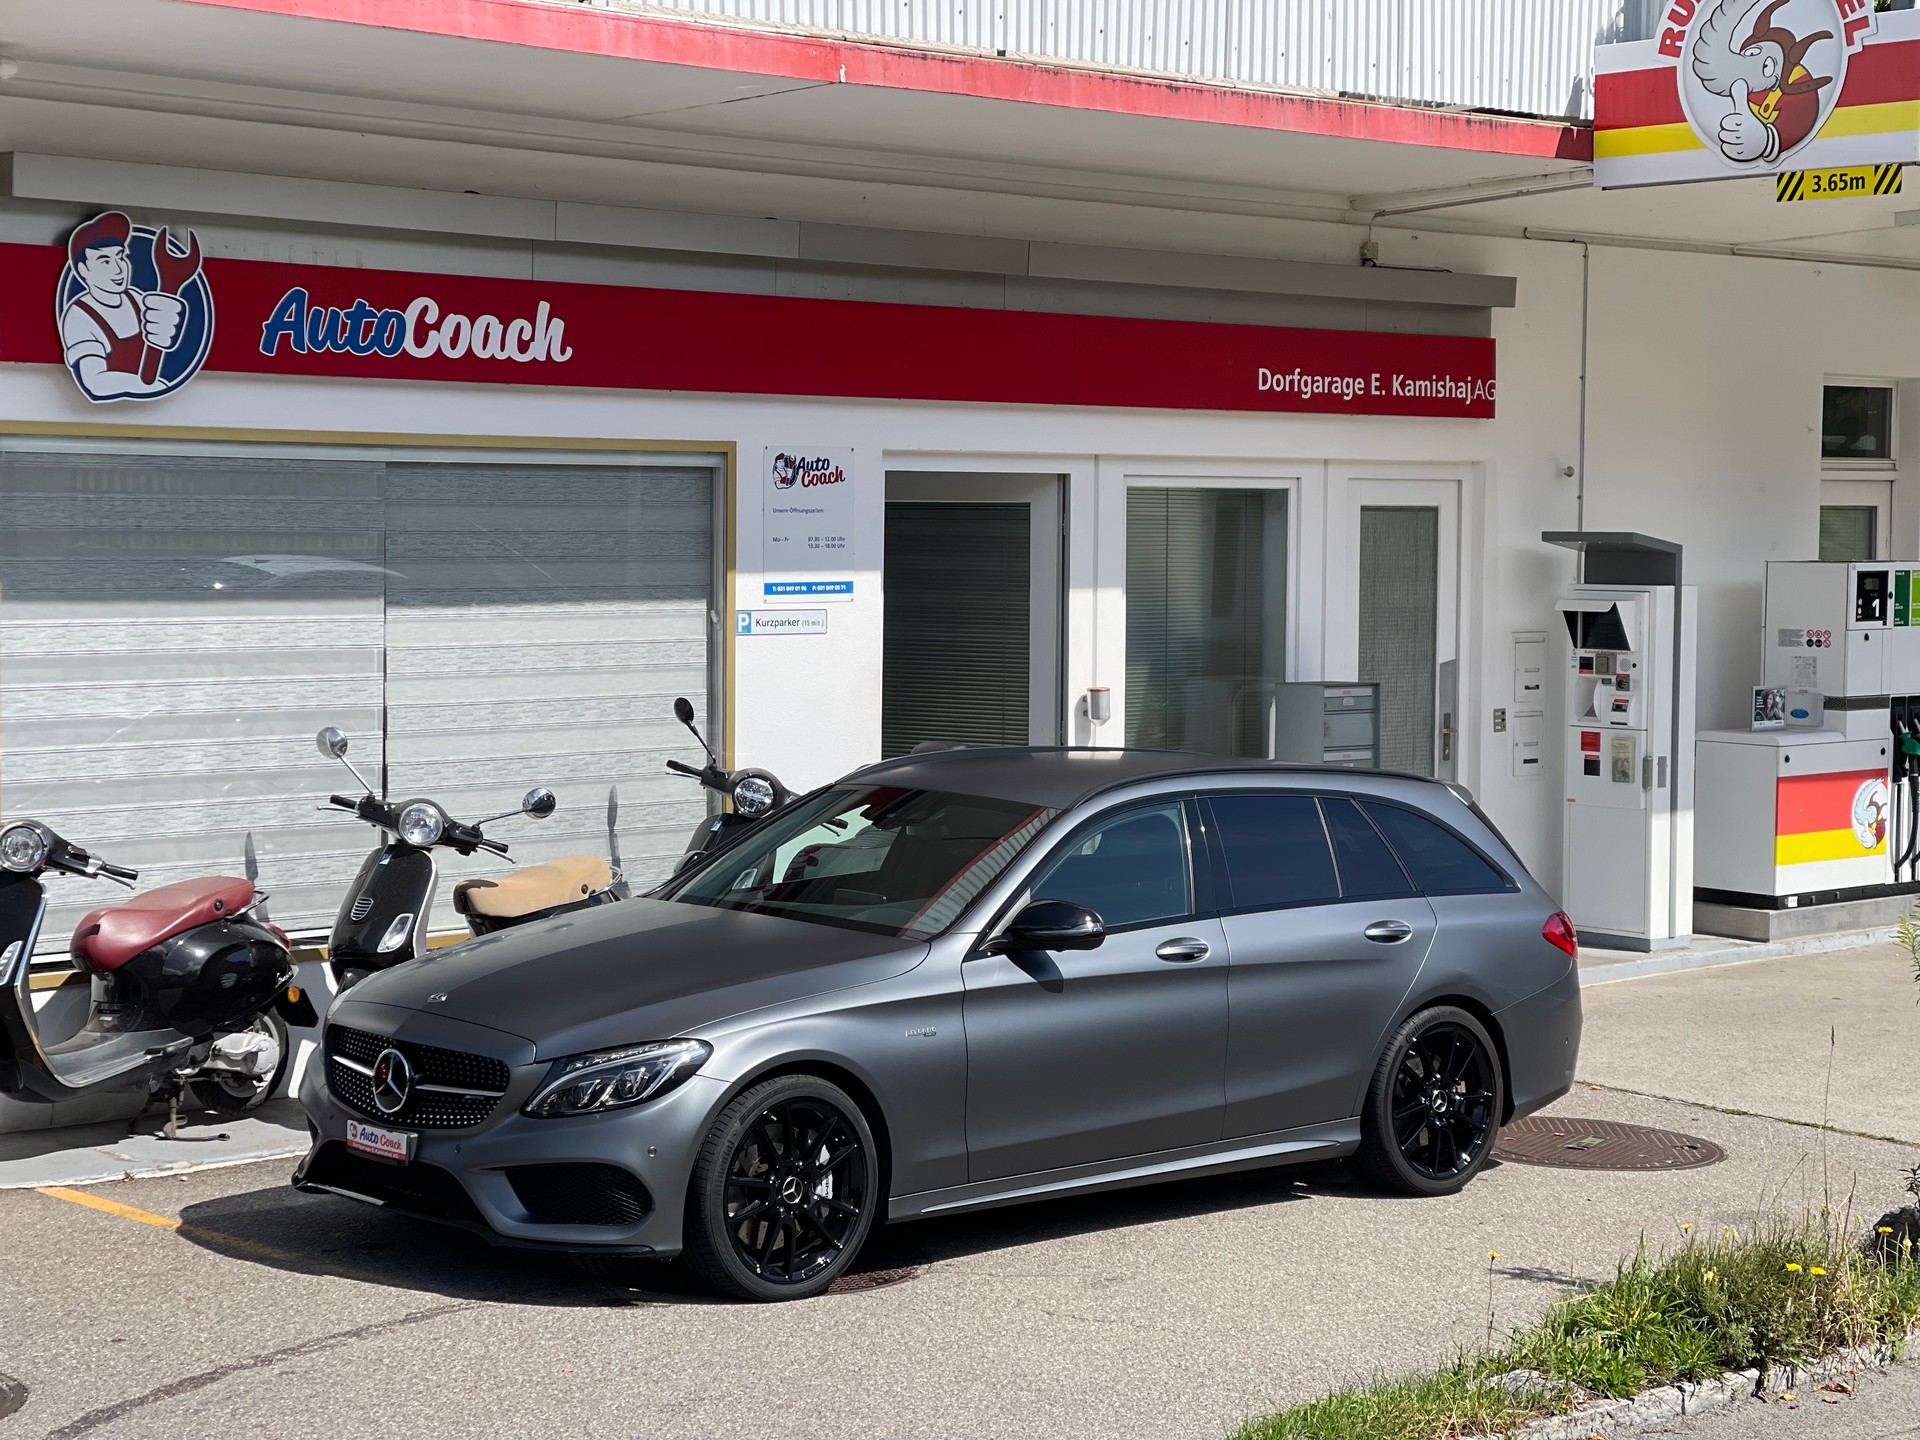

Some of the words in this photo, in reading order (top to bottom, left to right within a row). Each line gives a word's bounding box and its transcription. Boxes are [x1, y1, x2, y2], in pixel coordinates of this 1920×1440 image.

[1812, 173, 1866, 193] 3.65m
[1258, 367, 1365, 400] Dorfgarage
[1371, 373, 1386, 395] E.
[796, 456, 830, 475] Auto
[801, 465, 846, 488] Coach
[1871, 598, 1880, 617] 1
[755, 618, 800, 629] Kurzparker
[360, 1127, 379, 1145] Auto
[380, 1134, 402, 1150] Coach
